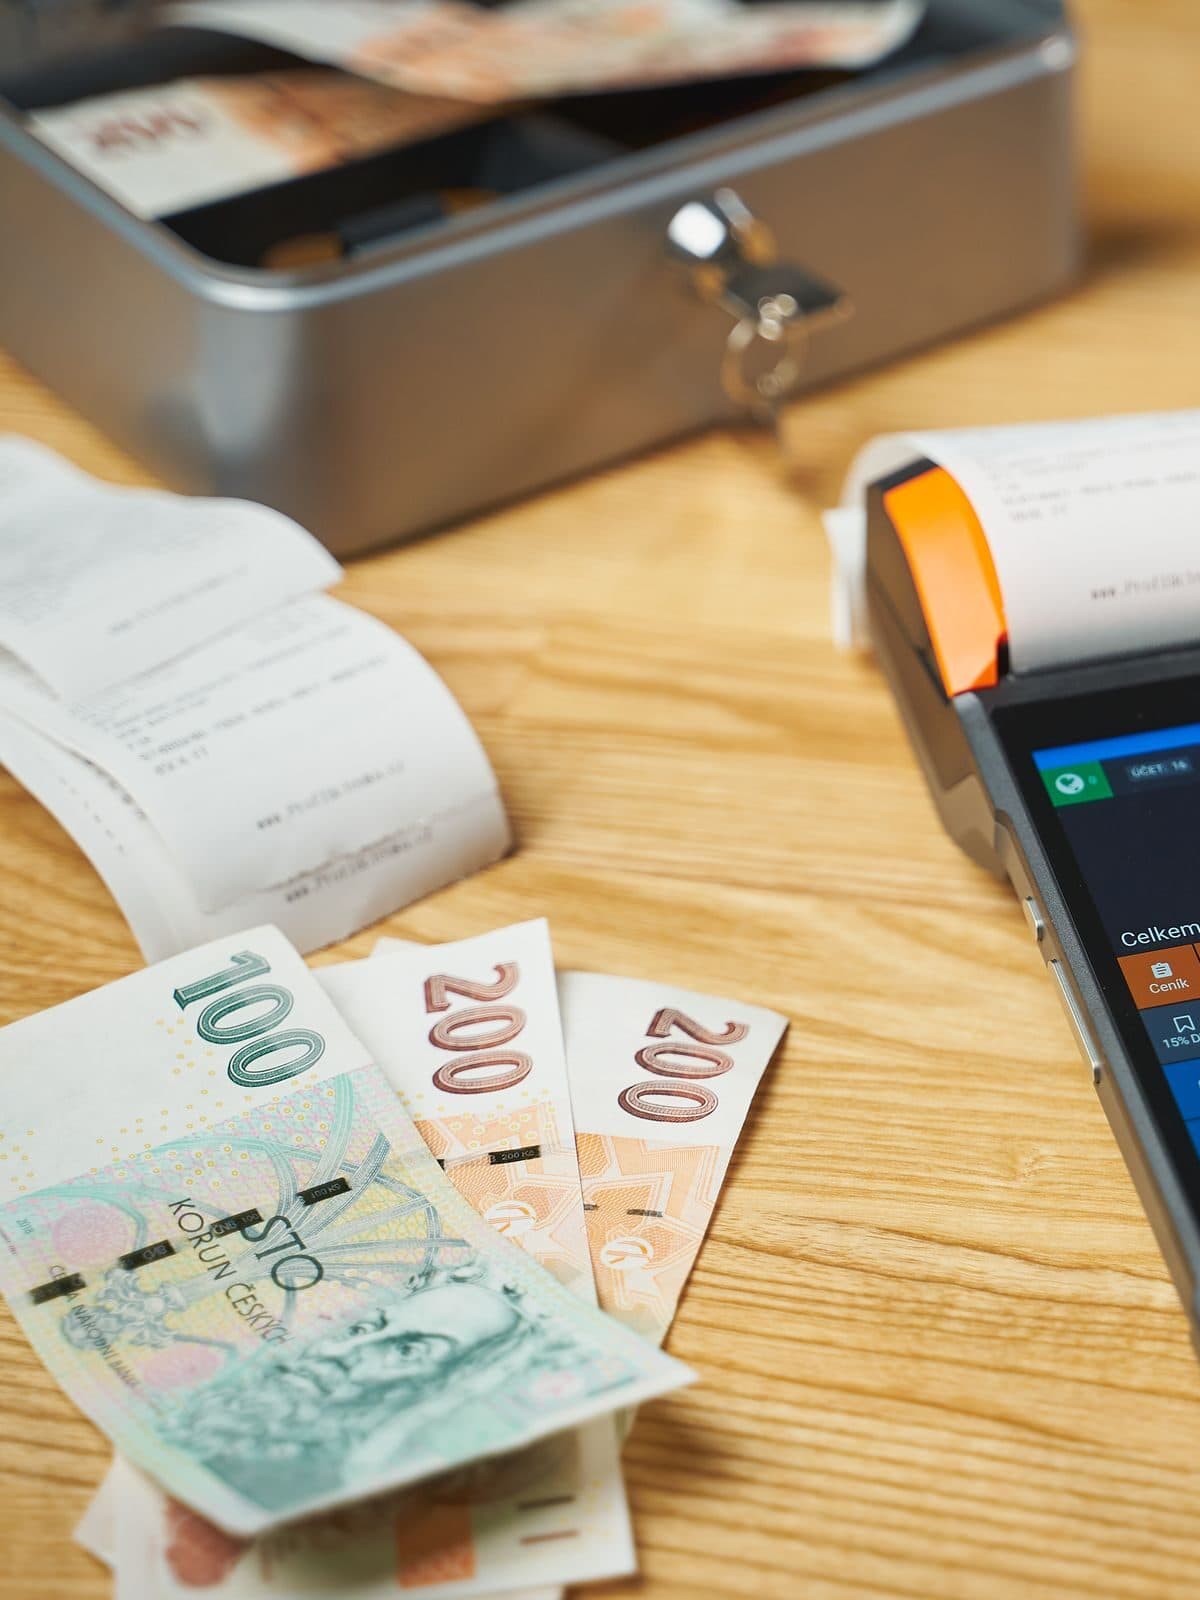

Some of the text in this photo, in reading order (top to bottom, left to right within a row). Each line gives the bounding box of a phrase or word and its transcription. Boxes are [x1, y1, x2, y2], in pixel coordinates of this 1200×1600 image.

[173, 950, 326, 1088] 100
[1149, 978, 1190, 994] Ceník
[424, 961, 533, 1095] 200
[618, 1008, 750, 1123] 200
[1162, 1035, 1189, 1049] 15%
[168, 1198, 237, 1280] KORUN
[240, 1215, 324, 1291] STO
[225, 1282, 294, 1344] ČESKÝCH
